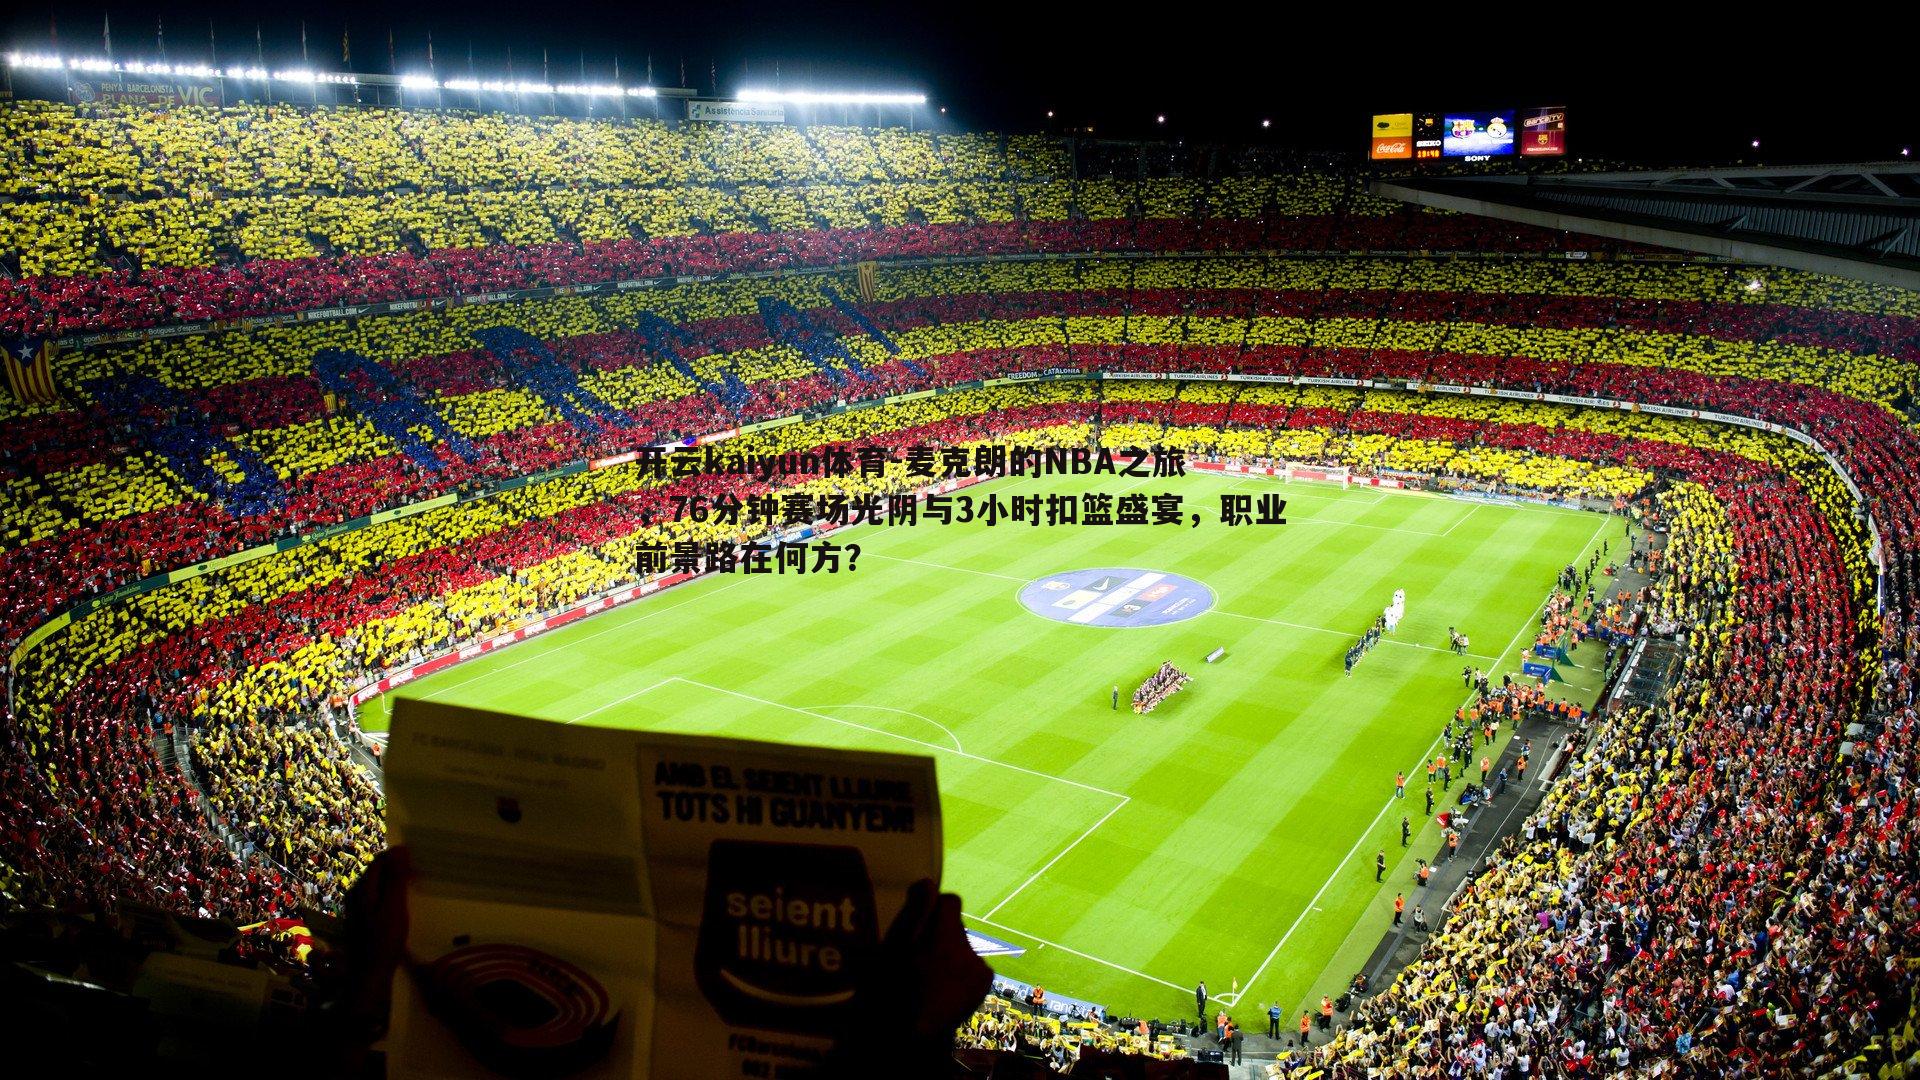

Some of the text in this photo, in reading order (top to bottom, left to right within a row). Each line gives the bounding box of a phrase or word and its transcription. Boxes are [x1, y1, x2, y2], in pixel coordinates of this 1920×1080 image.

[101, 83, 124, 92] PENYA
[103, 94, 175, 105] PLANA DE
[177, 85, 215, 106] VIC
[308, 307, 357, 320] NIKEFOOTBALL.COM
[1007, 371, 1038, 380] FREEDOM
[1043, 367, 1081, 376] CATALONIA
[1509, 391, 1534, 399] AIRLINES
[1558, 395, 1581, 404] TURKISH
[1660, 406, 1689, 416] AIRLINES
[1714, 414, 1763, 428] TURKISH AIRLINES
[655, 761, 911, 801] AMB EL SEIENT LLIURE
[657, 791, 914, 833] TOTS HI GUANYEM!
[725, 884, 857, 934] seient
[738, 922, 844, 975] lliure
